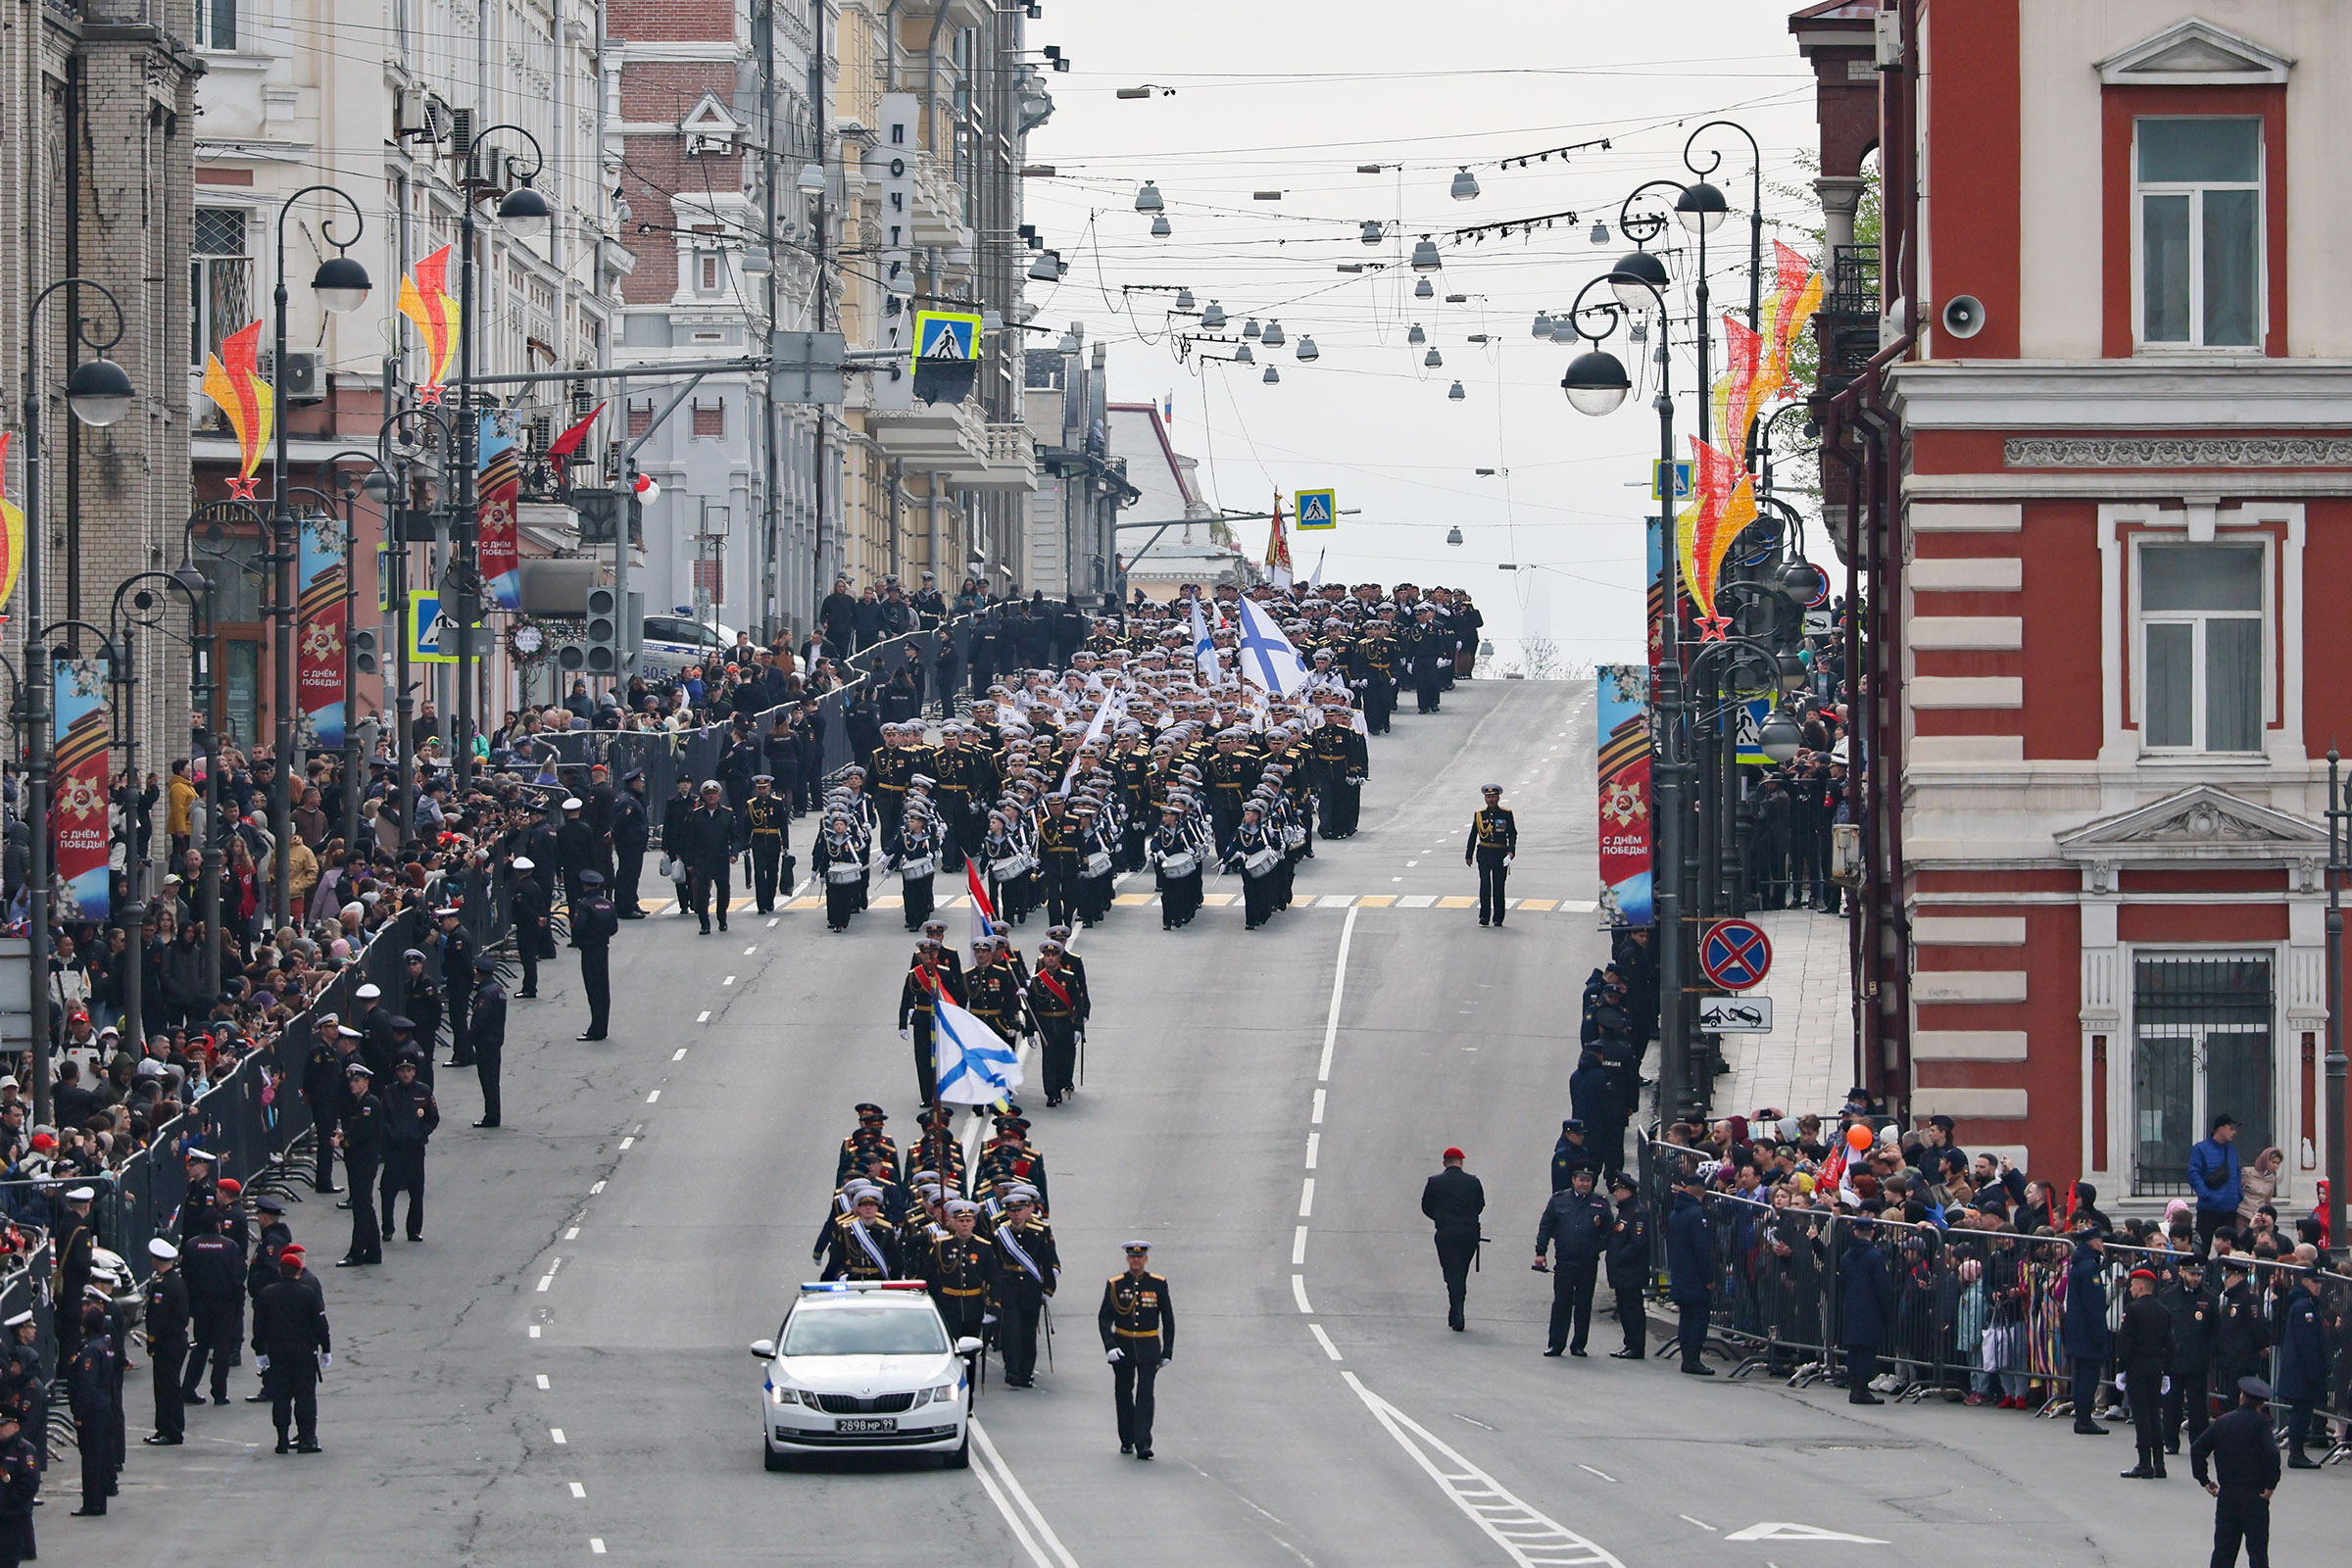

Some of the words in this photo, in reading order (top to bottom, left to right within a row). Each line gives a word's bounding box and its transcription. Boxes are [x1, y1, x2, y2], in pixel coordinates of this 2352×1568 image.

[312, 668, 337, 678] ДНЁМ
[302, 679, 342, 688] ПОБЕДЫ!
[60, 830, 68, 839] С
[71, 828, 100, 840] ДНЁМ
[60, 840, 106, 850] ПОБЕДЫ!
[1602, 836, 1611, 845] С
[1613, 834, 1642, 846] ДНЁМ
[1602, 846, 1648, 856] ПОБЕДЫ!
[882, 1418, 894, 1428] 99
